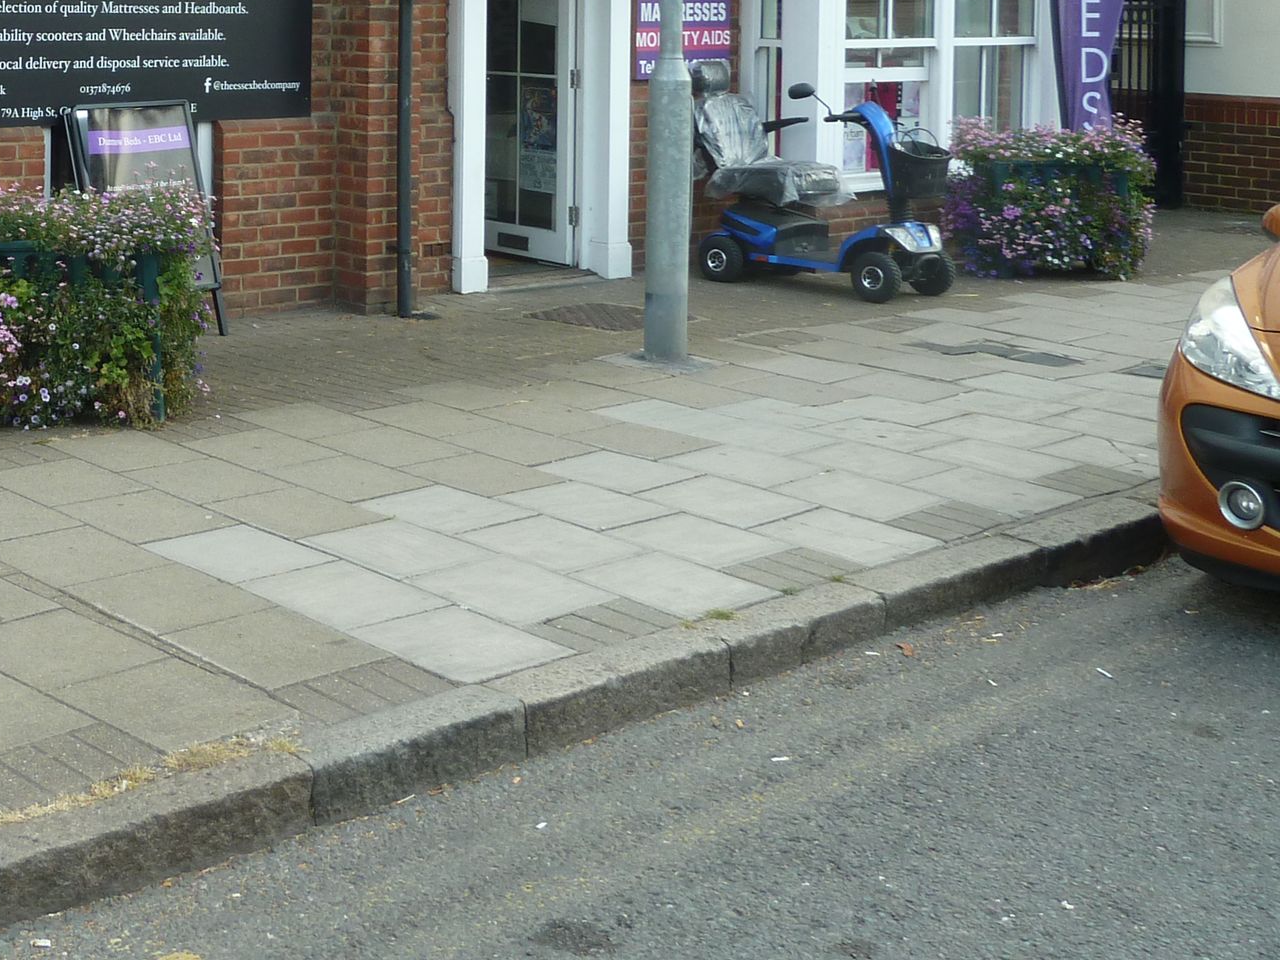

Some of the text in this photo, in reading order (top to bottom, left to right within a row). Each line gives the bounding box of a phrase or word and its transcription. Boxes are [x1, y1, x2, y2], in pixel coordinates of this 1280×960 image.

[44, 0, 60, 14] of
[60, 0, 99, 18] quality
[100, 1, 160, 15] Mattresses
[161, 1, 183, 14] and
[184, 1, 249, 15] Headboards.
[36, 31, 83, 41] scooters
[85, 28, 106, 41] and
[108, 28, 177, 41] Wheelchairs
[178, 28, 227, 41] available.
[701, 30, 731, 46] AIDS
[25, 56, 71, 73] delivery
[73, 56, 94, 70] and
[96, 55, 141, 72] disposal
[142, 56, 180, 69] service
[182, 55, 230, 68] available.
[79, 82, 131, 96] 01371874676
[0, 107, 20, 118] 79A
[21, 106, 43, 121] High
[45, 106, 58, 118] St,
[148, 134, 167, 144] EBC
[168, 132, 183, 142] Ltd
